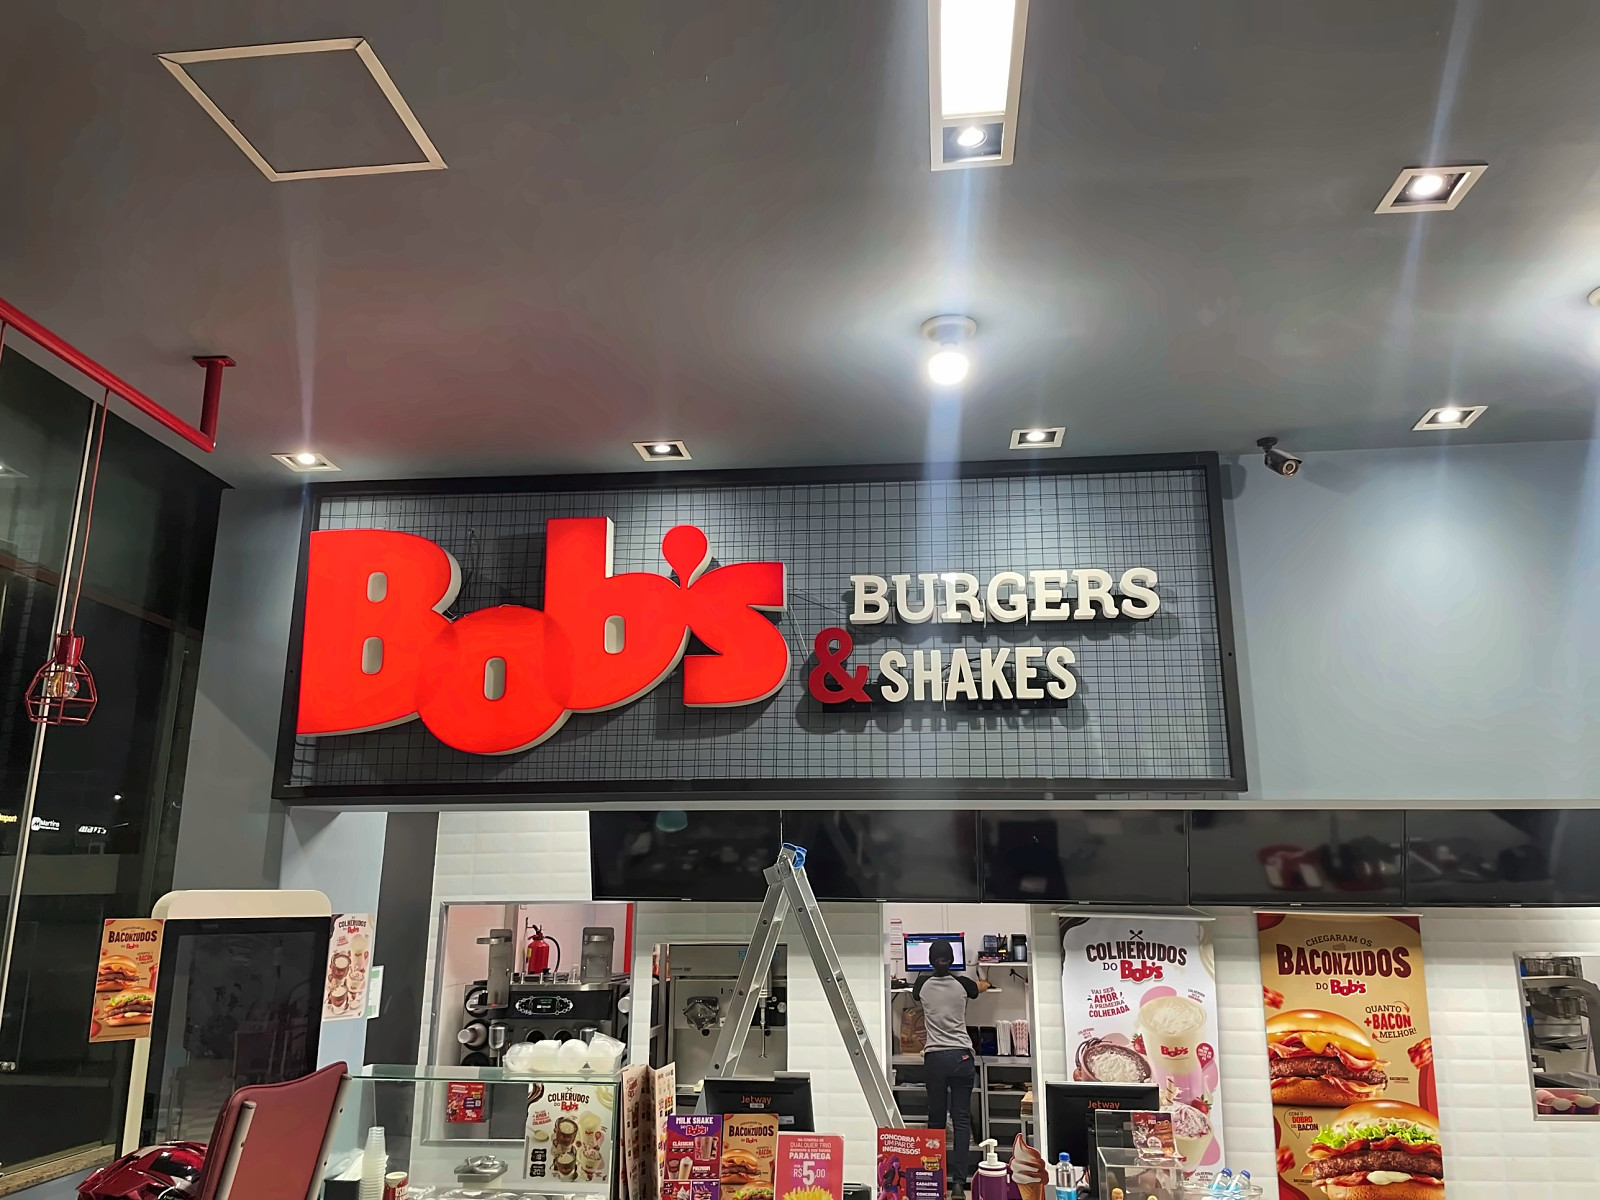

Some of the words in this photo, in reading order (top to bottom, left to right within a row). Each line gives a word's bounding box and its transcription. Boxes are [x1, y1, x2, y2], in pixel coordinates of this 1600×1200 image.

[849, 567, 1160, 625] BURGERS
[297, 516, 791, 755] Bob's
[809, 627, 872, 704] &
[879, 646, 1077, 702] SHAKES
[108, 930, 158, 943] BACONZUDOS
[1305, 934, 1359, 947] CHEGARAM
[1360, 937, 1373, 947] OS
[1086, 940, 1188, 966] COLHERUDOS
[1276, 944, 1412, 978] BACONZUDOS
[1103, 962, 1118, 971] DO
[1120, 959, 1164, 982] Bob's
[1315, 982, 1329, 991] DO
[1330, 979, 1367, 997] Bob's
[1094, 992, 1118, 1003] AMOR
[1095, 1000, 1125, 1009] PRIMEIRA
[1365, 1005, 1402, 1013] QUANTO
[1089, 1005, 1130, 1018] COLHERADA
[1379, 1027, 1417, 1038] MELHOR!
[1161, 1046, 1188, 1058] Bob's
[547, 1092, 590, 1104] COLHERUDOS
[740, 1095, 772, 1106] Jetway
[560, 1101, 579, 1112] Bob's
[1087, 1100, 1121, 1110] Jetway
[676, 1117, 691, 1125] MILK
[692, 1117, 714, 1125] SHAKE
[1292, 1116, 1313, 1124] DOBRO
[728, 1125, 775, 1137] BACONZUDOS
[1297, 1123, 1318, 1131] BACON
[880, 1133, 915, 1143] CONCORRA
[789, 1152, 809, 1160] PARA
[882, 1146, 921, 1155] INGRESSOS!
